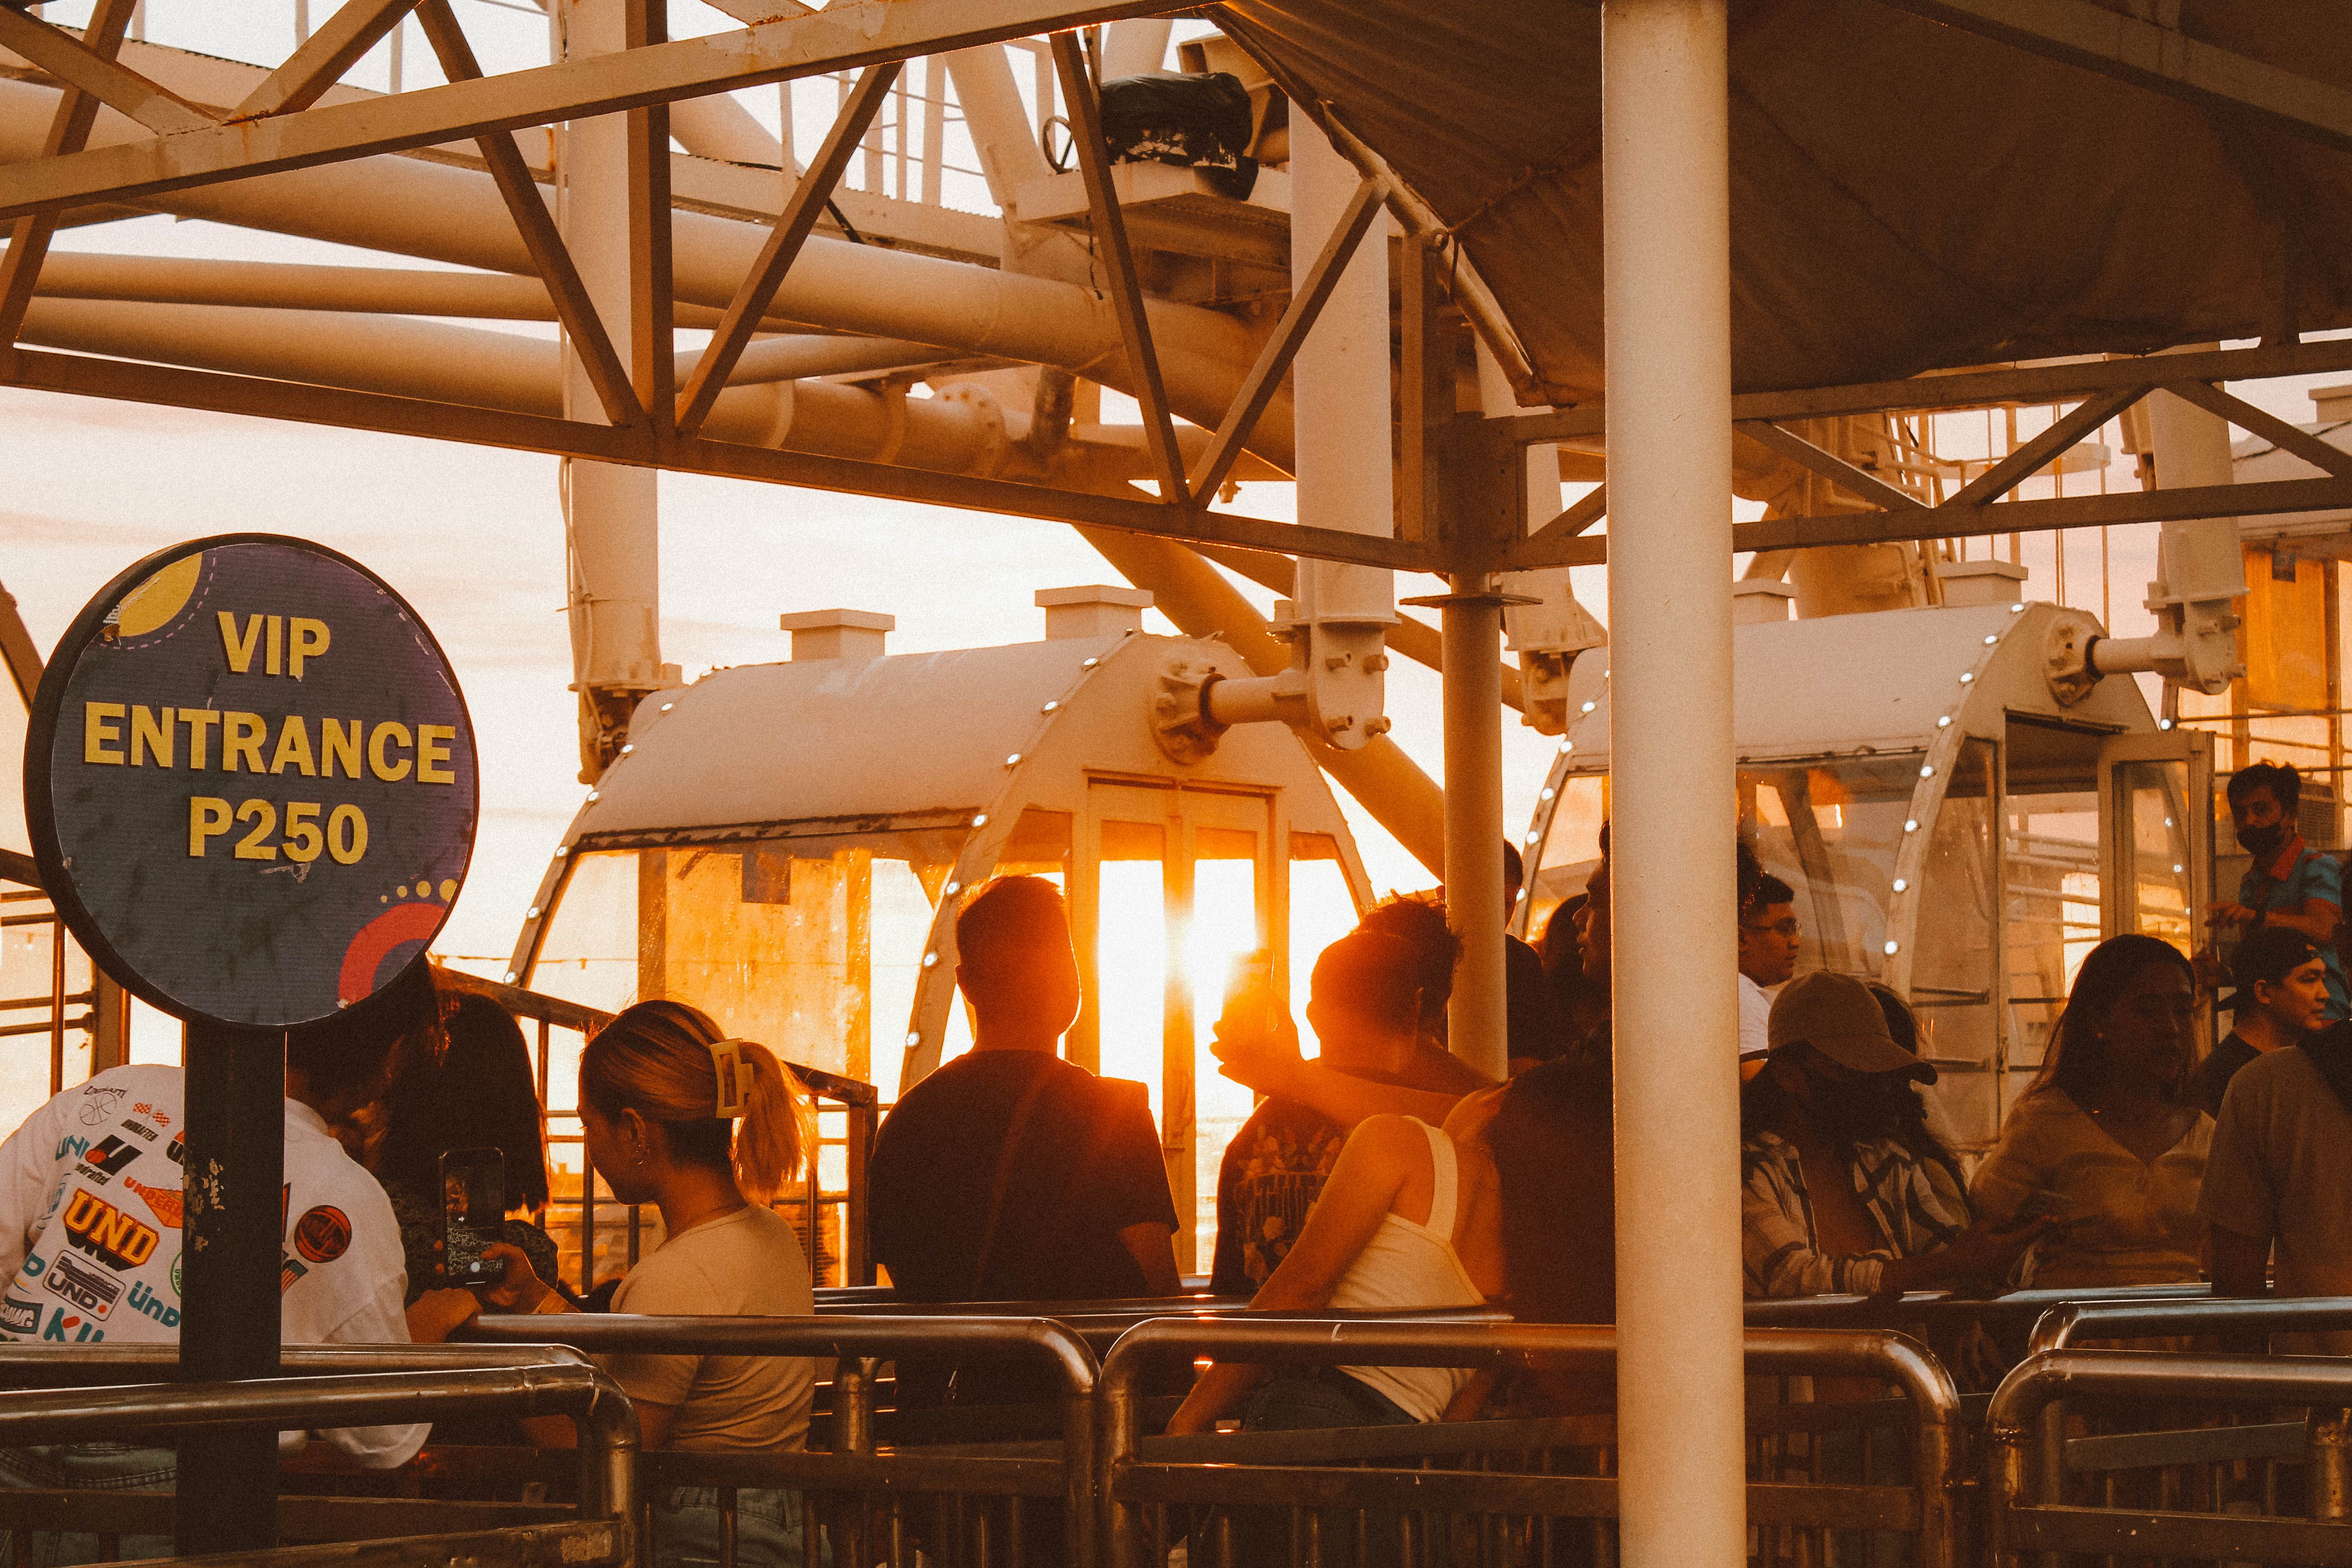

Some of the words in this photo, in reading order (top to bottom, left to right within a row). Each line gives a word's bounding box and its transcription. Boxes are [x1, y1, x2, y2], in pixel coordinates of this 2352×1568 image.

[217, 611, 331, 680] VIP
[84, 701, 456, 784] ENTRANCE
[190, 796, 368, 865] P250
[63, 1187, 160, 1267] UND
